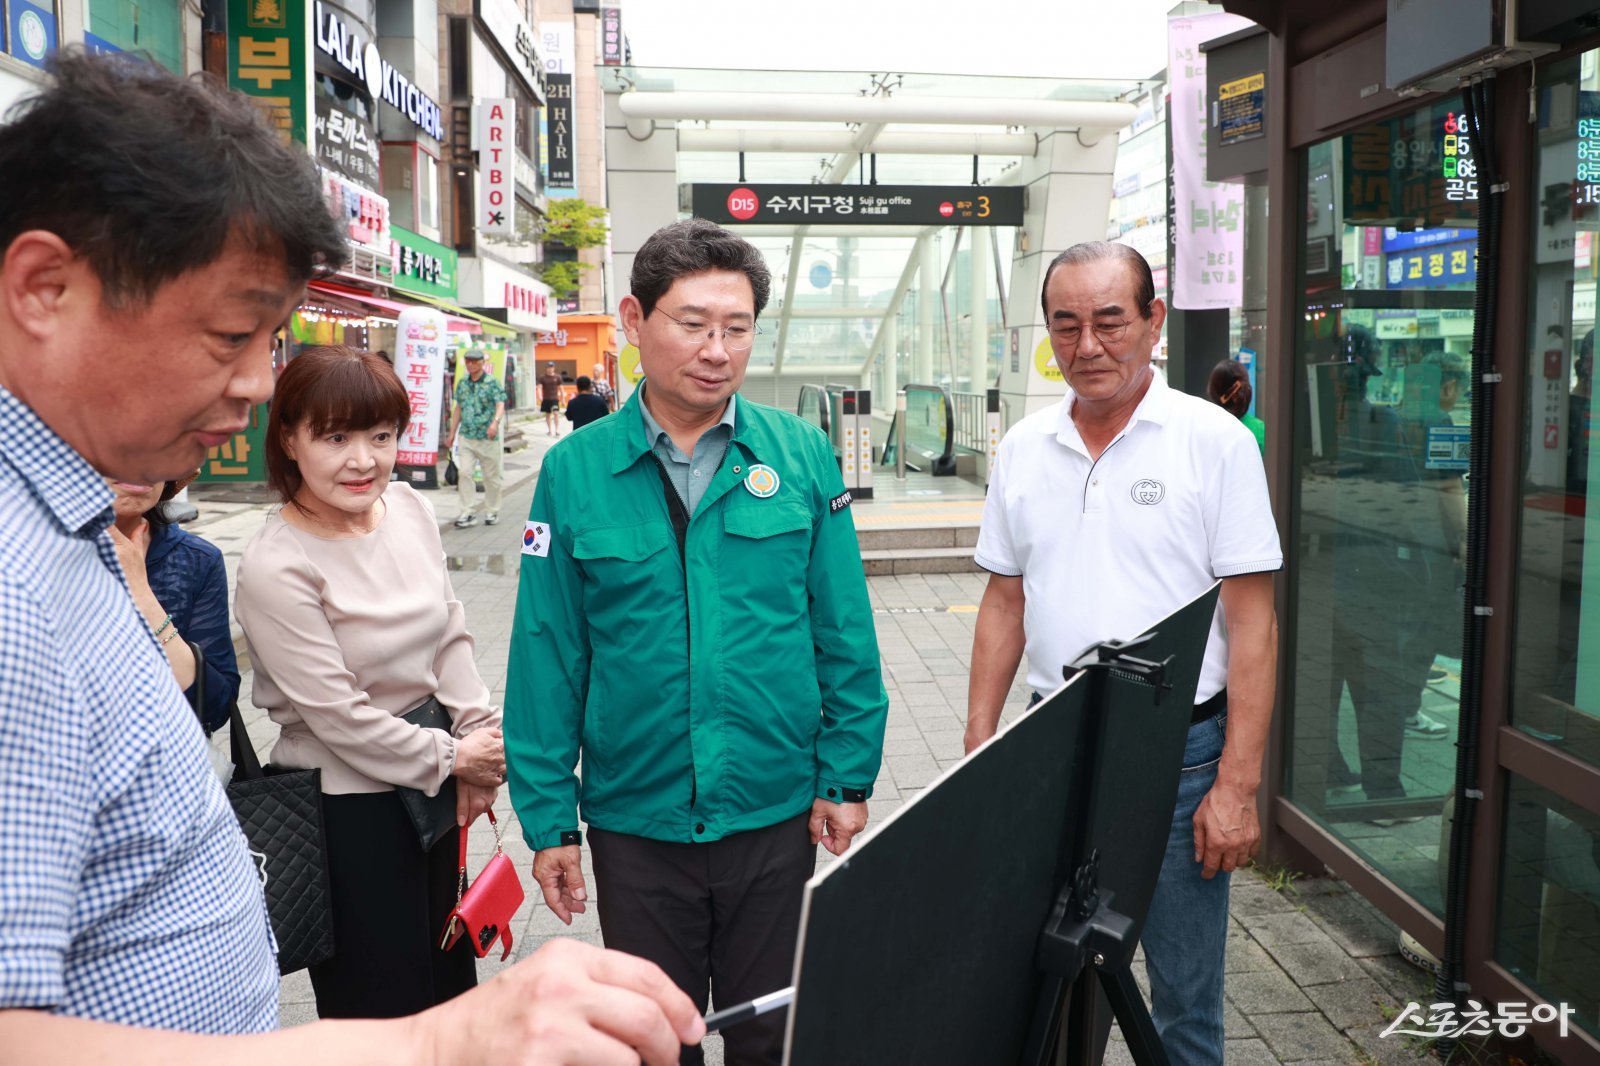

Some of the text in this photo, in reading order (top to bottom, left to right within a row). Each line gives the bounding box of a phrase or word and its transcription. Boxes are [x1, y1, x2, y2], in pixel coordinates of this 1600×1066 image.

[316, 0, 365, 81] LALA
[382, 59, 443, 141] KITCHEN
[547, 84, 571, 98] 2H
[553, 107, 568, 159] HAIR
[731, 198, 755, 211] D15
[765, 195, 854, 214] 수지구청
[859, 196, 912, 207] Suji gu office
[977, 195, 991, 217] 3
[1408, 250, 1479, 279] 교정전
